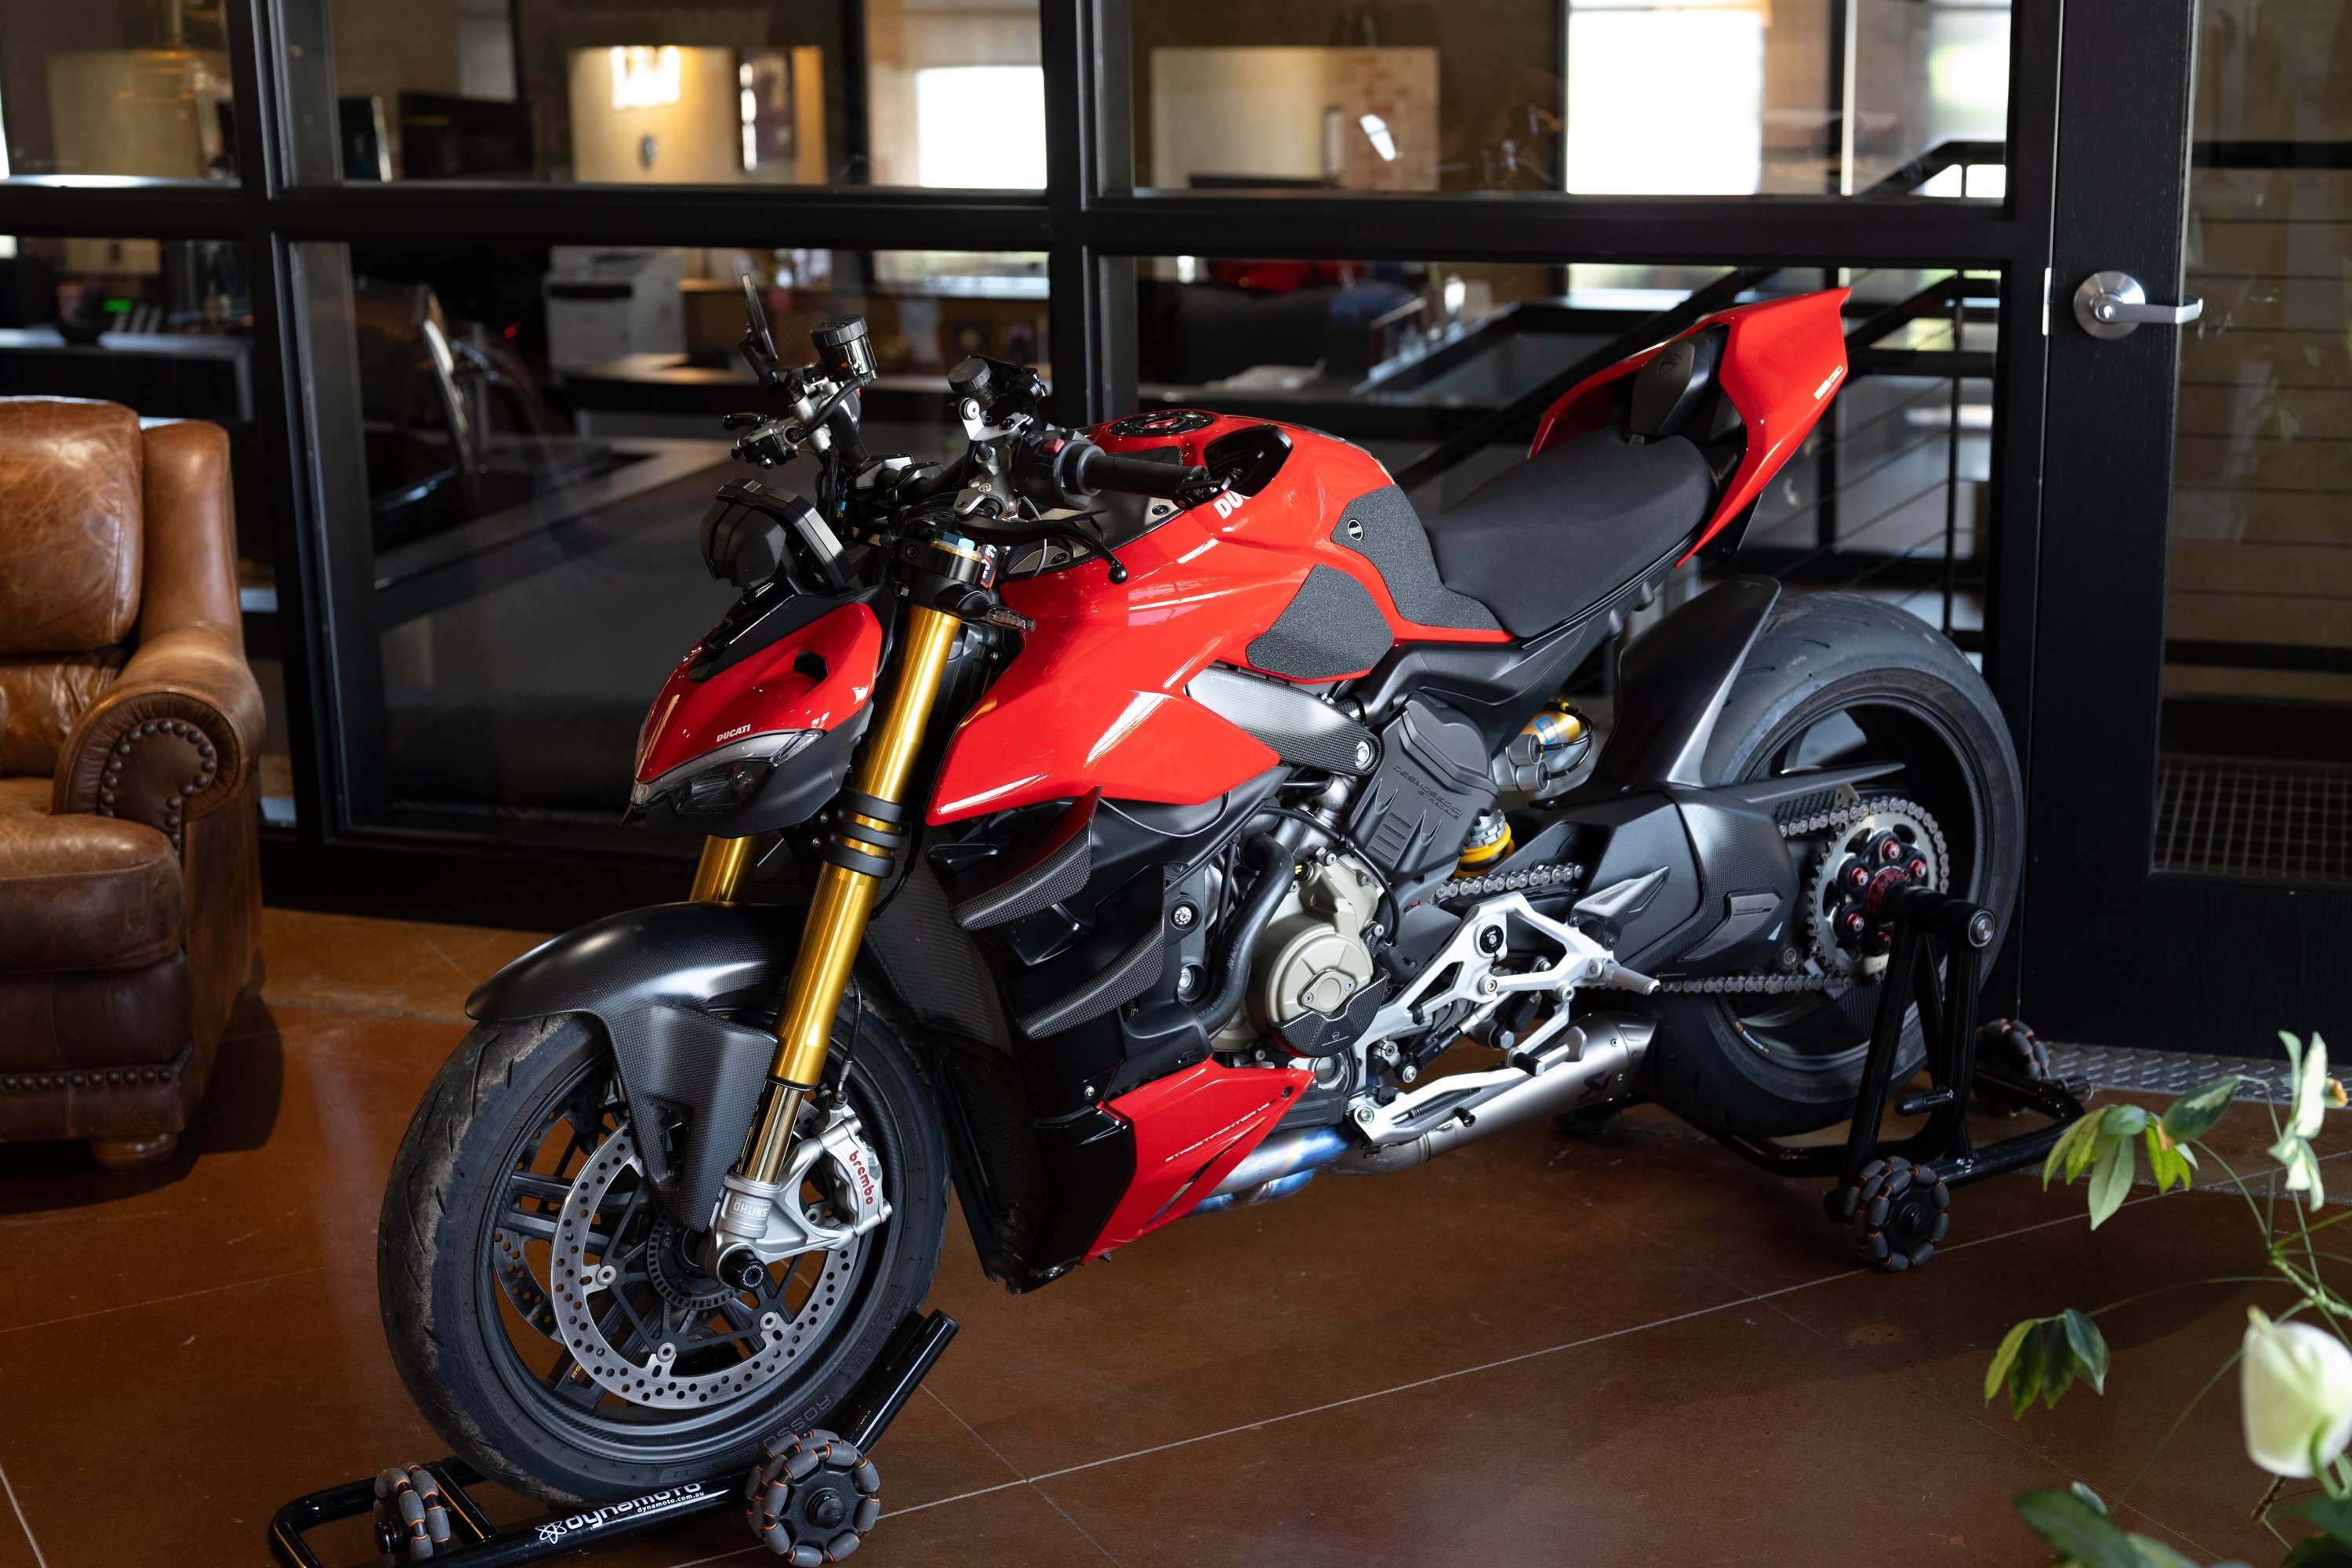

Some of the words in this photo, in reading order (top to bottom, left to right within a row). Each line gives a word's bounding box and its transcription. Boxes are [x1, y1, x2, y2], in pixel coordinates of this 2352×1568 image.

[1213, 490, 1252, 520] DU
[716, 724, 751, 742] DUCATI
[1392, 765, 1464, 816] DESMOSEDICI
[1165, 1110, 1256, 1163] STREETFIGHTER
[849, 1150, 874, 1205] brembo
[733, 1200, 768, 1218] ÖHLINS
[852, 1282, 907, 1371] DIABLO
[762, 1395, 832, 1450] ROSSO
[565, 1483, 702, 1529] dynamoto
[637, 1492, 705, 1514] dynamoto.com.au
